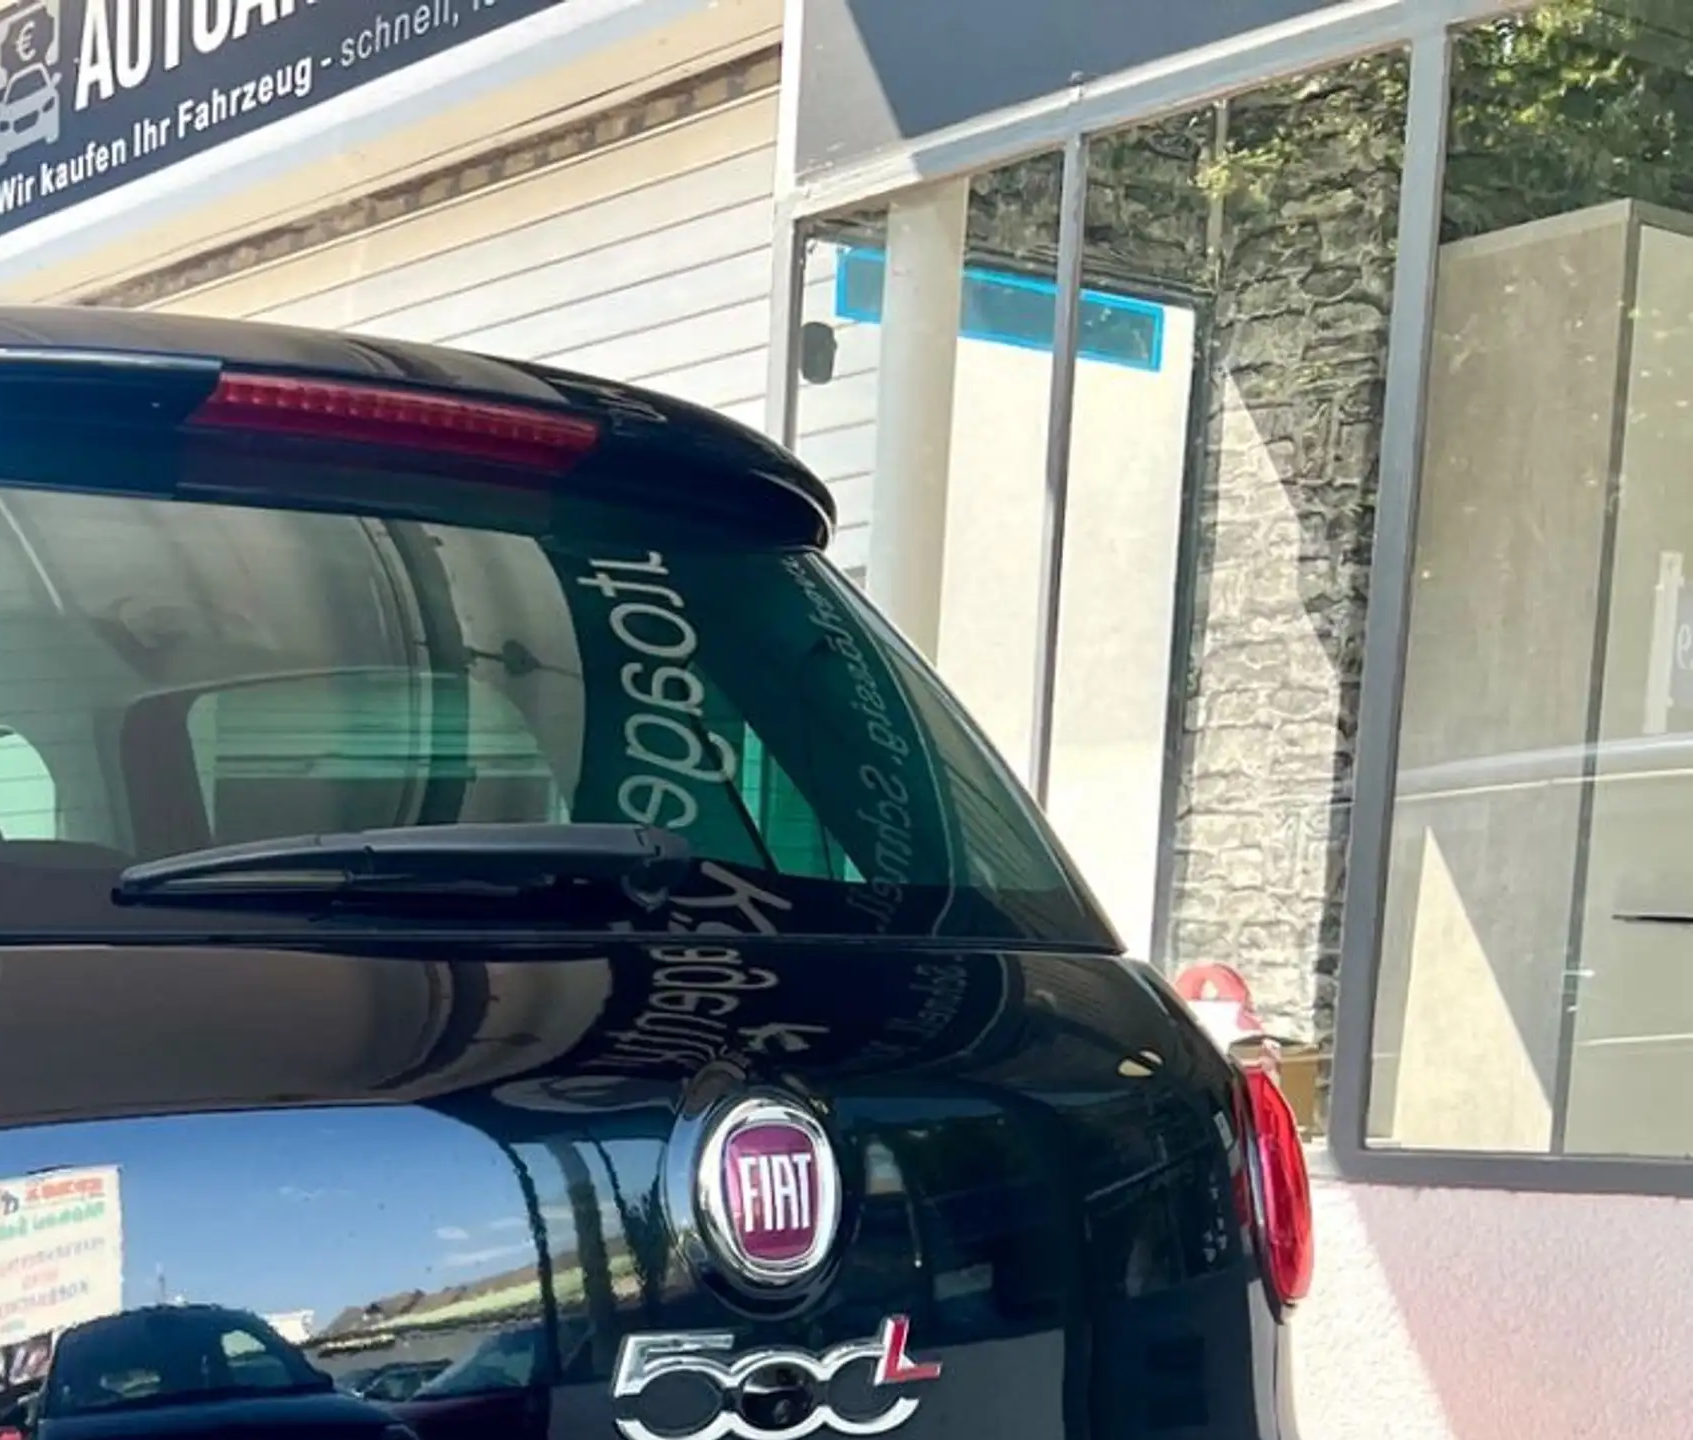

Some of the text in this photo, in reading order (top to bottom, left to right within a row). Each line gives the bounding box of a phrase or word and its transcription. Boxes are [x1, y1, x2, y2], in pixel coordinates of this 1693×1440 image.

[40, 136, 126, 197] kaufen
[133, 117, 170, 158] Ihr
[177, 56, 312, 139] Fahrzeug
[340, 0, 459, 68] schnell,
[738, 1152, 811, 1232] FIAT
